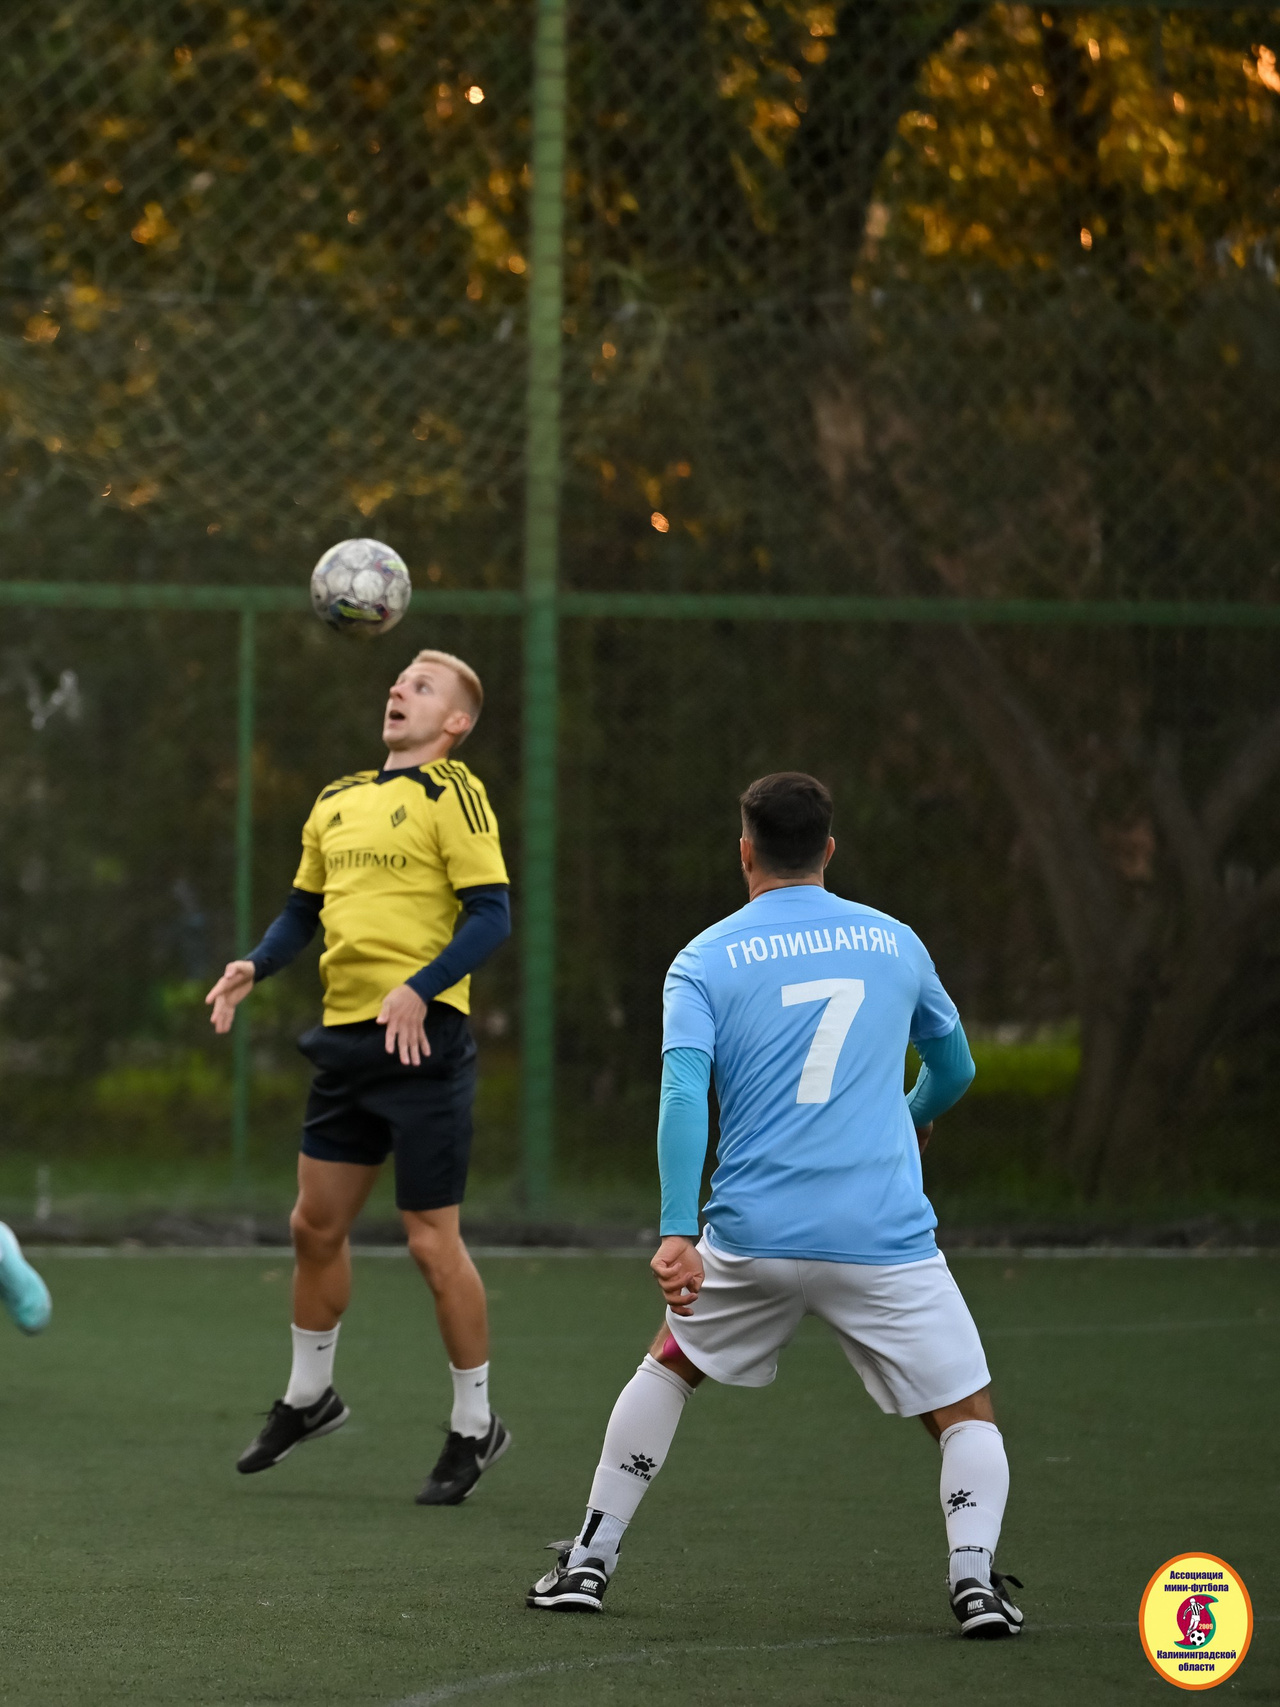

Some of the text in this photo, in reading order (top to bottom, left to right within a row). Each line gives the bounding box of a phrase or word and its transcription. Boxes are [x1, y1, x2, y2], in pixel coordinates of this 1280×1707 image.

[725, 925, 900, 968] ГЮЛИШАНЯН
[780, 977, 866, 1104] 7
[947, 1502, 977, 1518] KELME
[580, 1578, 599, 1590] NIKE
[967, 1598, 984, 1611] NIKE
